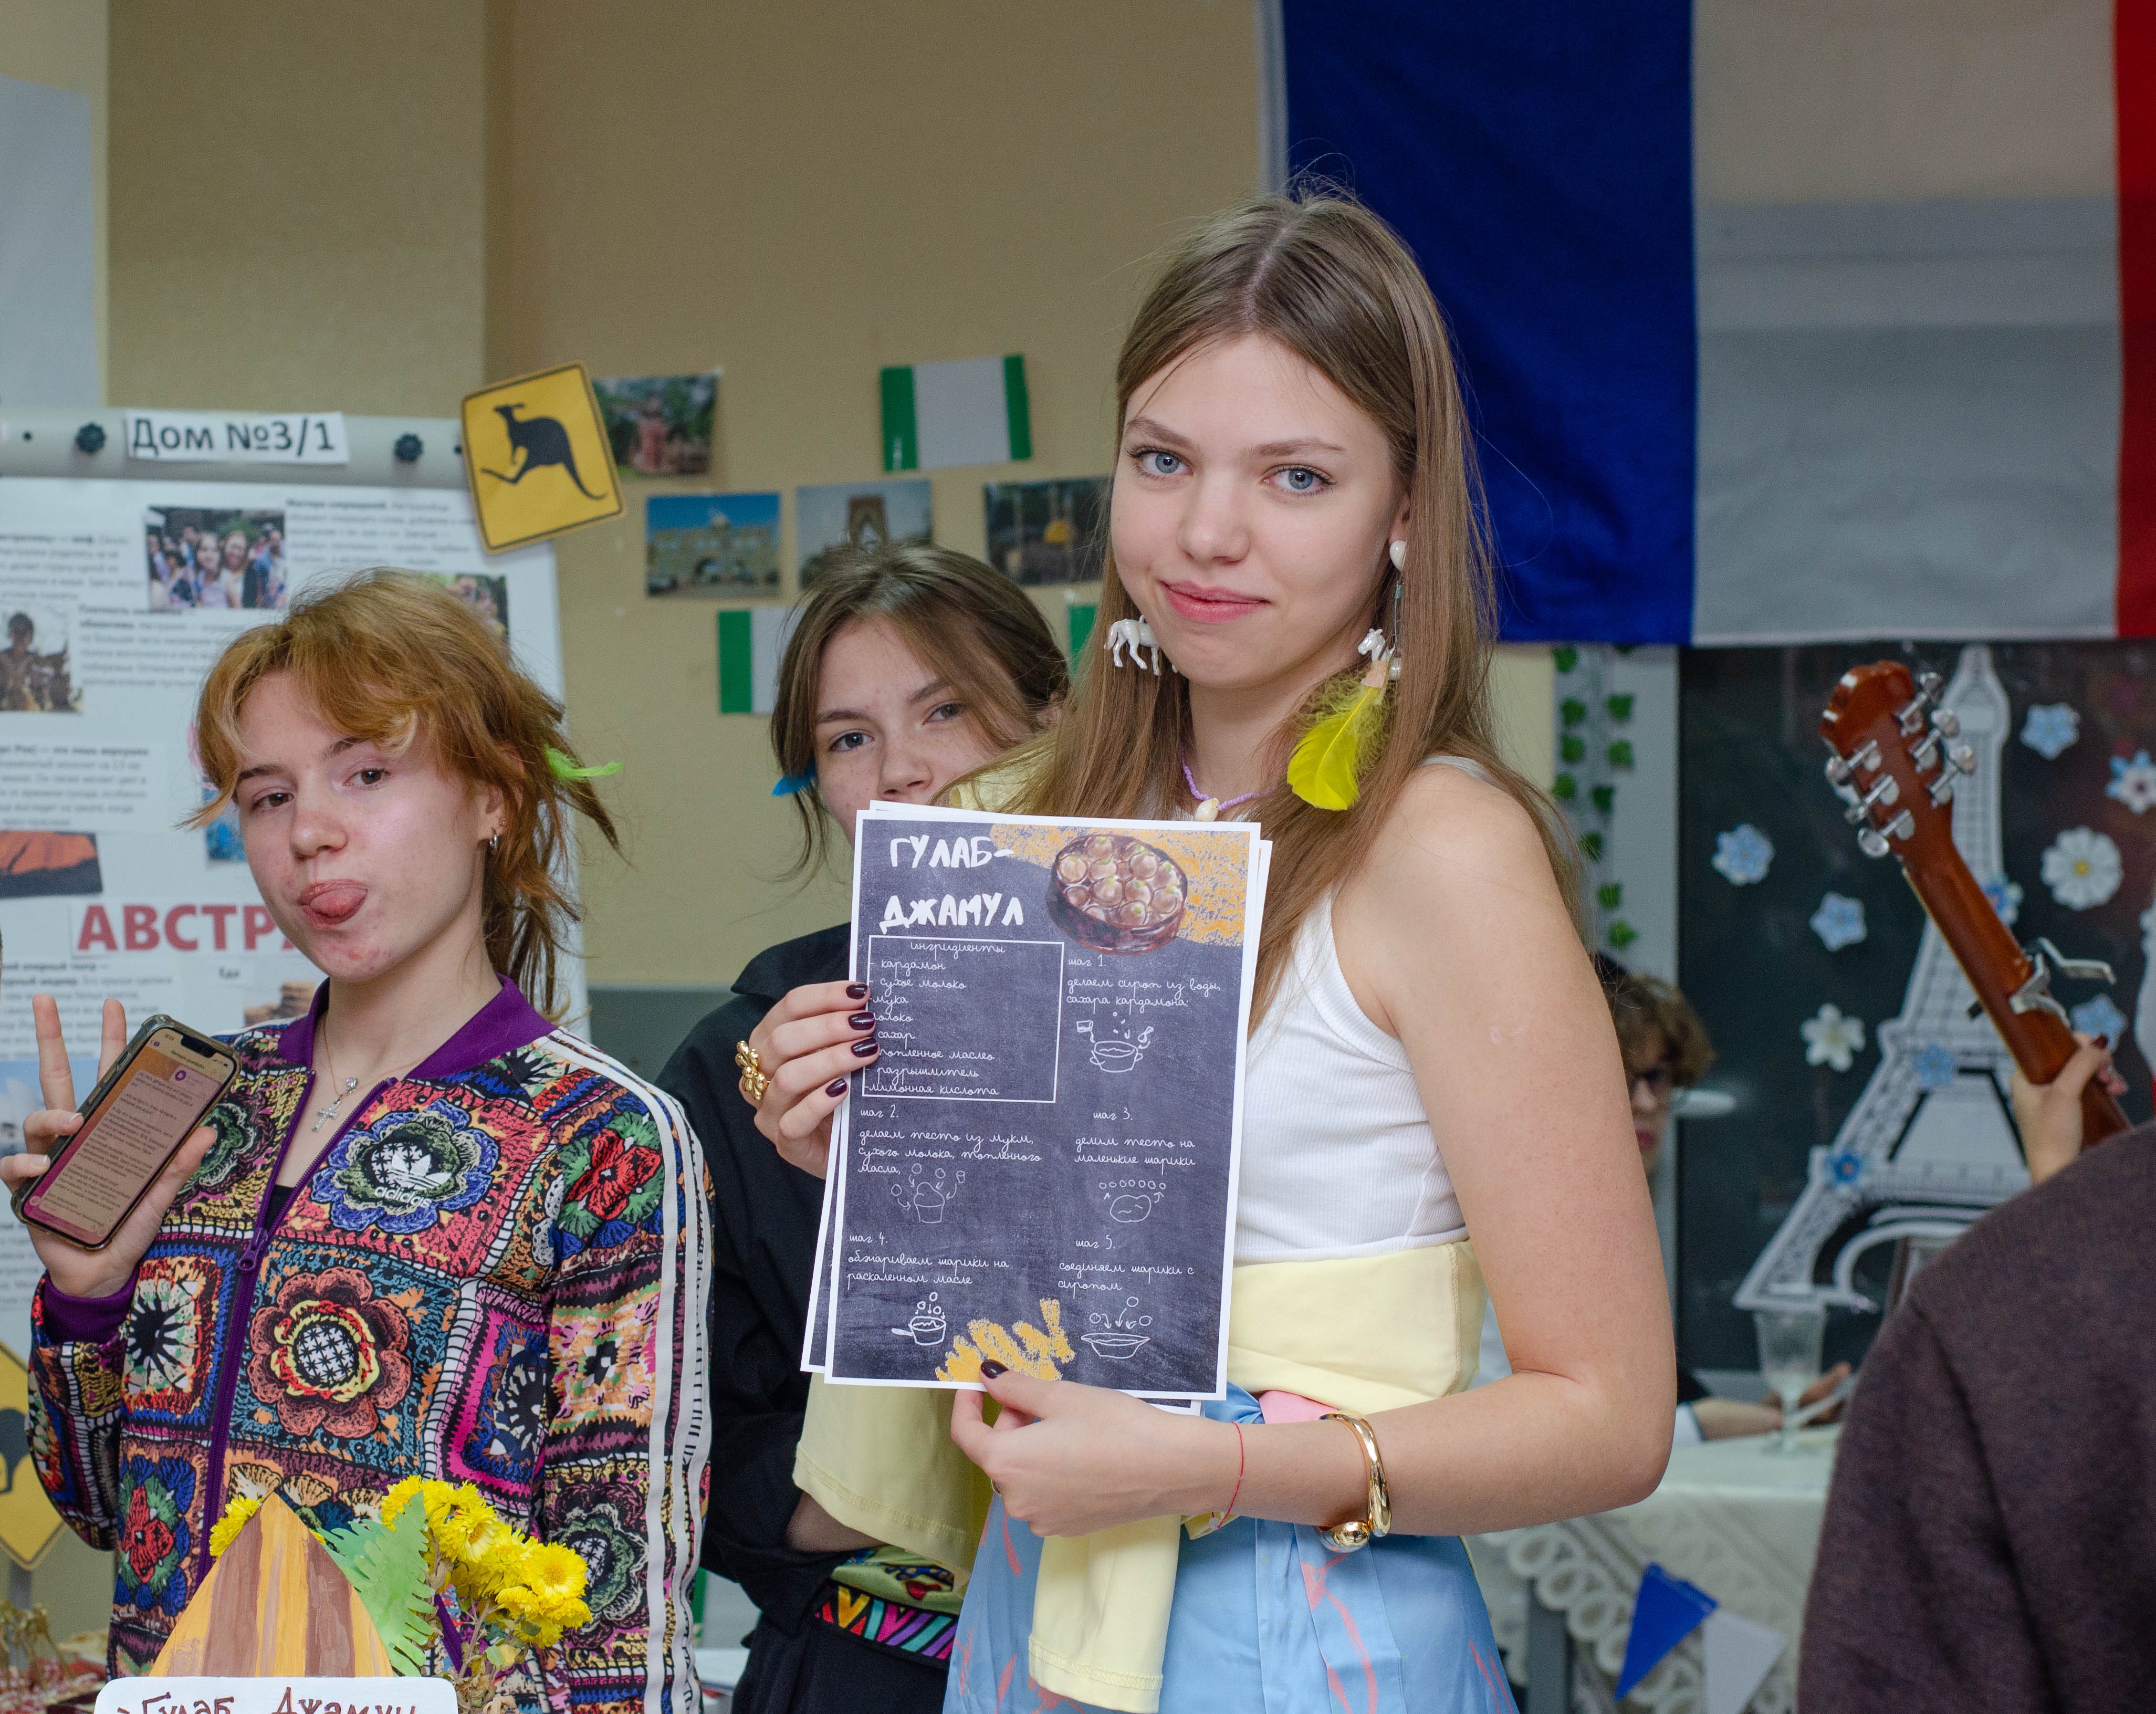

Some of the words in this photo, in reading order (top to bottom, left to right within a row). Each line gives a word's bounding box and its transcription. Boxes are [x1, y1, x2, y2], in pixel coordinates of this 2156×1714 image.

[133, 417, 214, 456] Дом
[226, 416, 335, 457] №3/1
[890, 834, 1014, 869] ГУЛАБ-
[879, 892, 1024, 935] ДЖАМУЛ
[77, 904, 299, 952] АВСТР
[910, 942, 1006, 961] ингридиенты
[1068, 958, 1092, 967] шаг
[1097, 954, 1106, 967] 1.
[881, 959, 946, 978] кардамон
[880, 978, 914, 997] сухое
[919, 979, 967, 989] молоко
[1067, 978, 1113, 994] делаем
[1118, 980, 1162, 998] сироп
[1167, 981, 1185, 999] из
[1190, 978, 1221, 998] воды,
[1066, 996, 1110, 1015] сахара
[1115, 996, 1189, 1016] кардамона:
[878, 1031, 915, 1050] сахар
[940, 1085, 999, 1095] кислота
[860, 1109, 884, 1117] шаг
[890, 1104, 899, 1118] 2.
[1093, 1112, 1117, 1121] шаг
[1123, 1107, 1133, 1121] 3.
[860, 1130, 905, 1146] делаем
[910, 1132, 961, 1141] тесто
[966, 1133, 984, 1153] из
[1075, 1137, 1119, 1153] делим
[1124, 1138, 1176, 1148] тесто
[859, 1147, 899, 1167] сухого
[905, 1149, 955, 1159] молока,
[961, 1150, 1042, 1162] топленного
[1074, 1154, 1139, 1164] маленькие
[1144, 1156, 1196, 1176] шарики
[857, 1164, 901, 1175] масла,
[374, 1186, 432, 1208] adidas
[849, 1235, 873, 1243] шаг
[879, 1231, 888, 1246] 4.
[1075, 1240, 1100, 1249] шаг
[1105, 1235, 1116, 1249] 5.
[847, 1249, 933, 1274] обжариваем
[937, 1258, 989, 1276] шарики
[846, 1272, 928, 1291] раскаленном
[933, 1275, 973, 1284] масле
[1059, 1262, 1125, 1279] соединяем
[1131, 1265, 1183, 1284] шарики
[1187, 1267, 1195, 1275] с
[1058, 1280, 1122, 1299] сиропом
